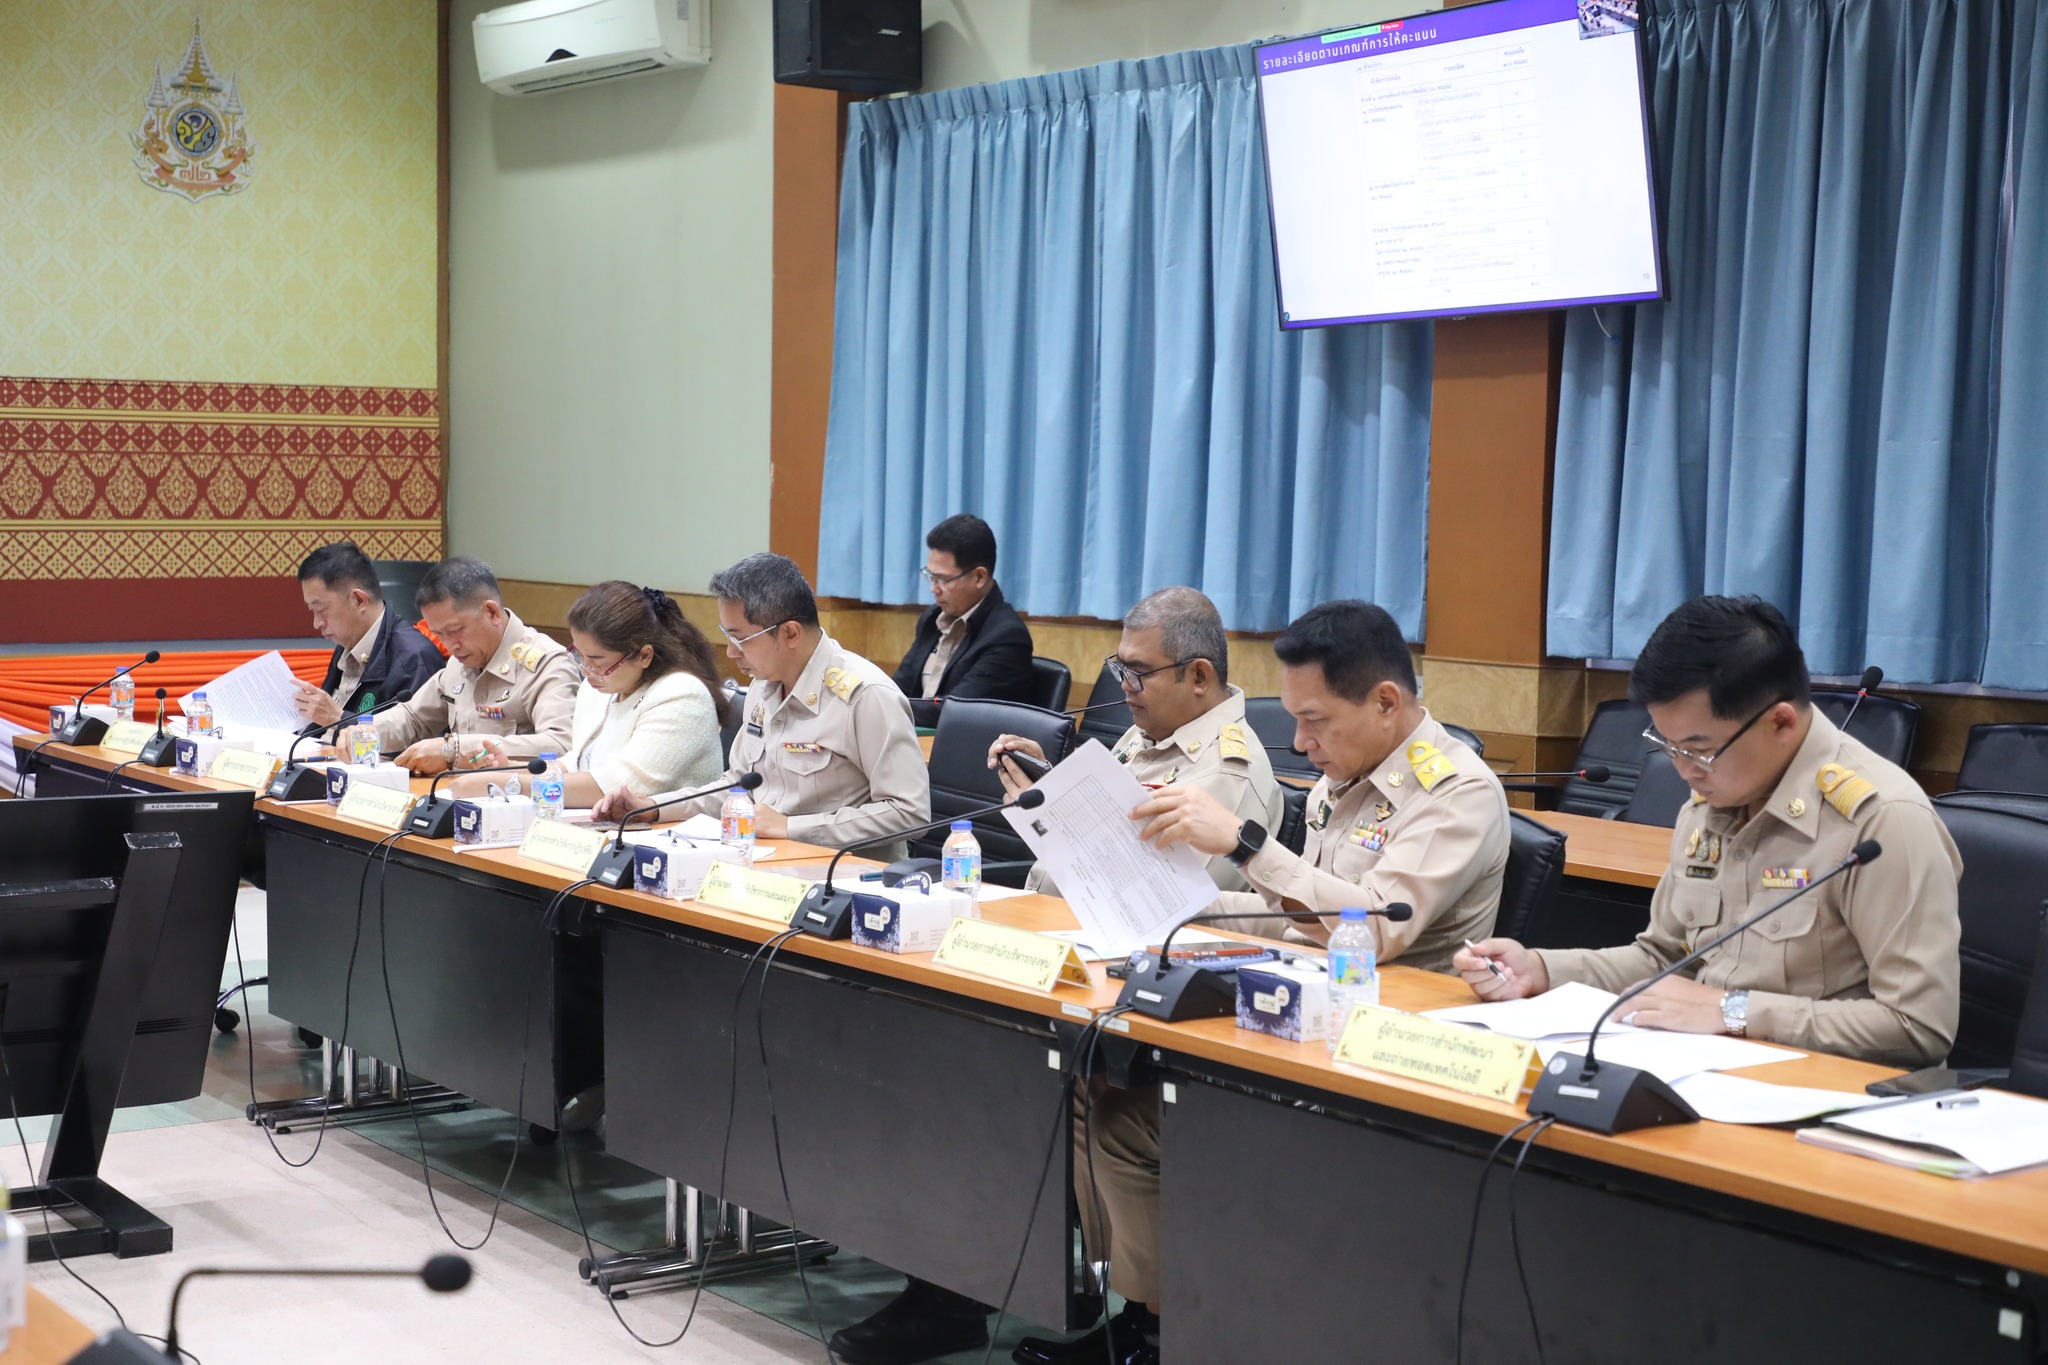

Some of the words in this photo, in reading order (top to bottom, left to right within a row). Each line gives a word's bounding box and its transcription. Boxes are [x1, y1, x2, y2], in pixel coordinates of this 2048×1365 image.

[1263, 28, 1437, 70] รายละเอียดตามเกณฑ์การให้คะแนน
[1377, 1020, 1495, 1060] ผู้อำนวยการสำนักพัฒนา
